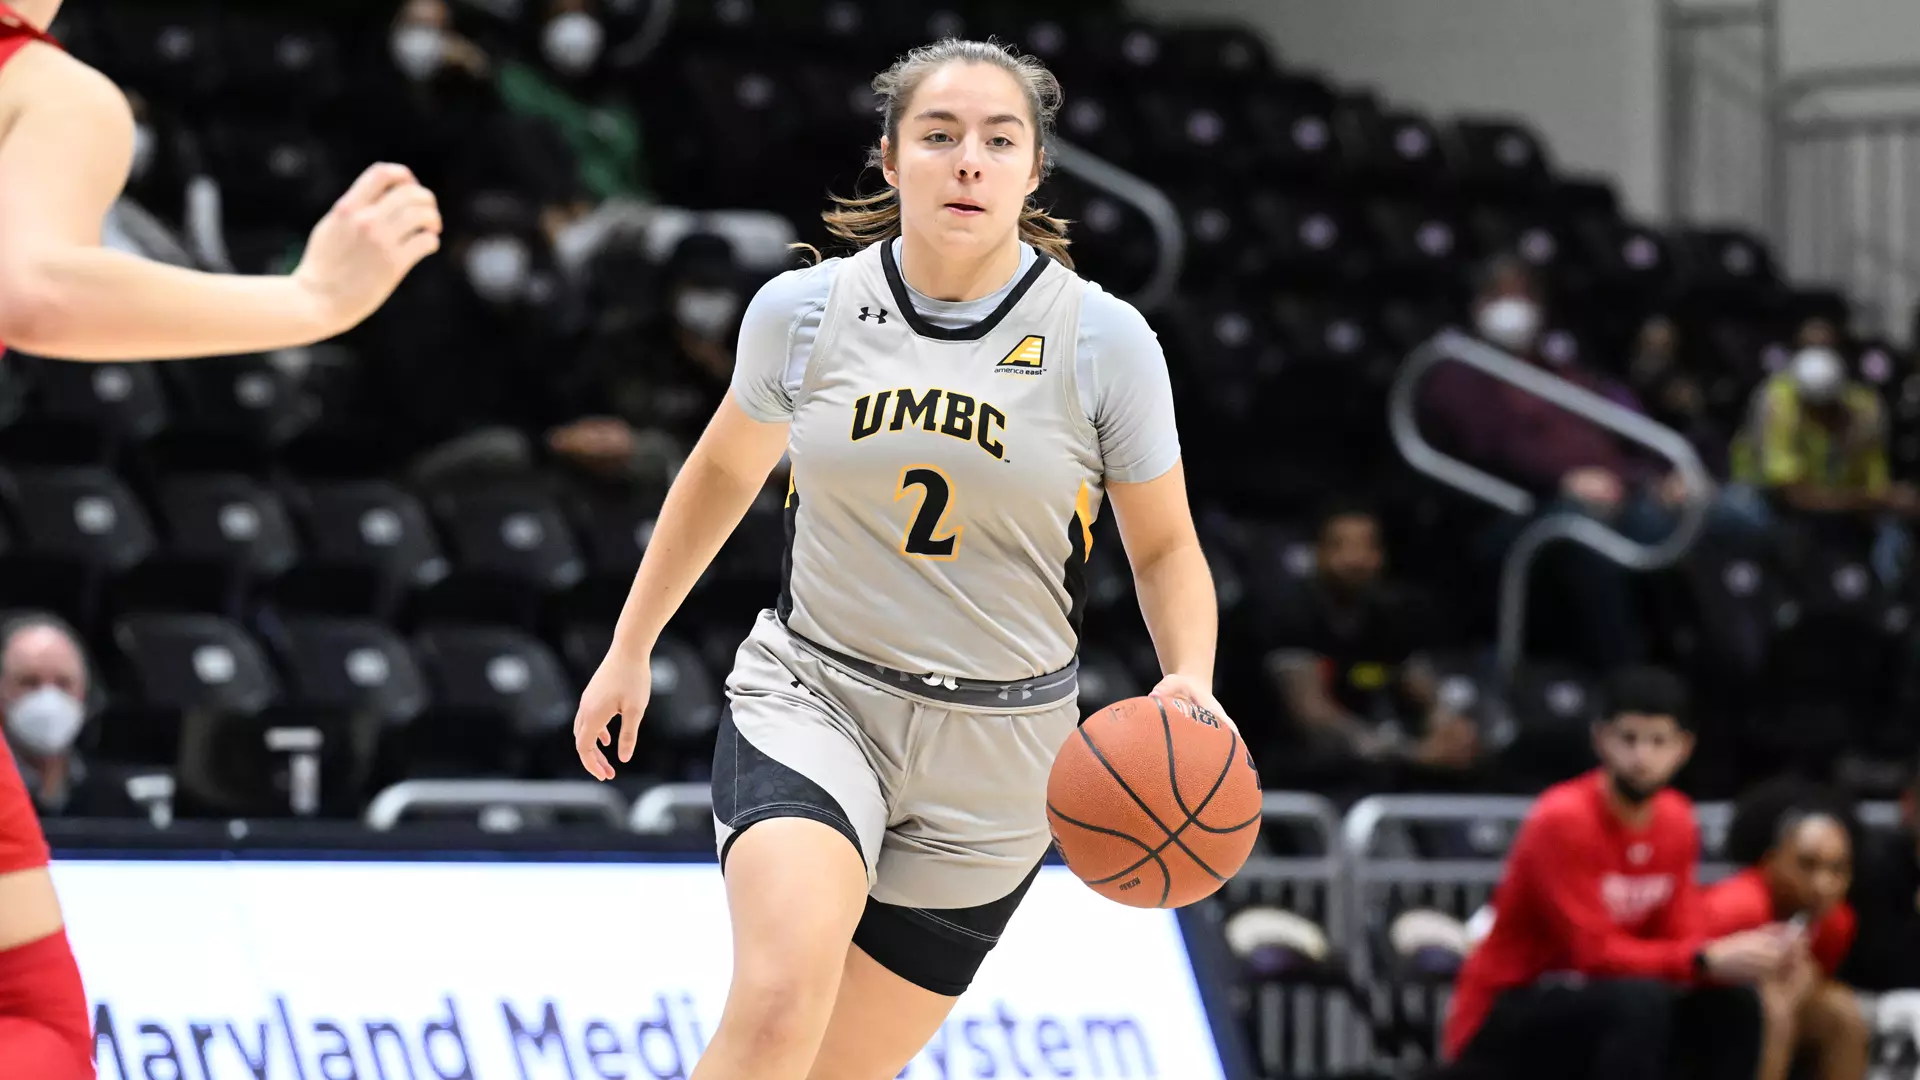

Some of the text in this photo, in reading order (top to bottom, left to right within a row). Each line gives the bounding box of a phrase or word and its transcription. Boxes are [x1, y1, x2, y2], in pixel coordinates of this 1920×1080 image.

[851, 388, 1006, 460] UMBC
[894, 463, 964, 561] 2
[499, 995, 712, 1080] Medi
[893, 1000, 1160, 1080] ystem
